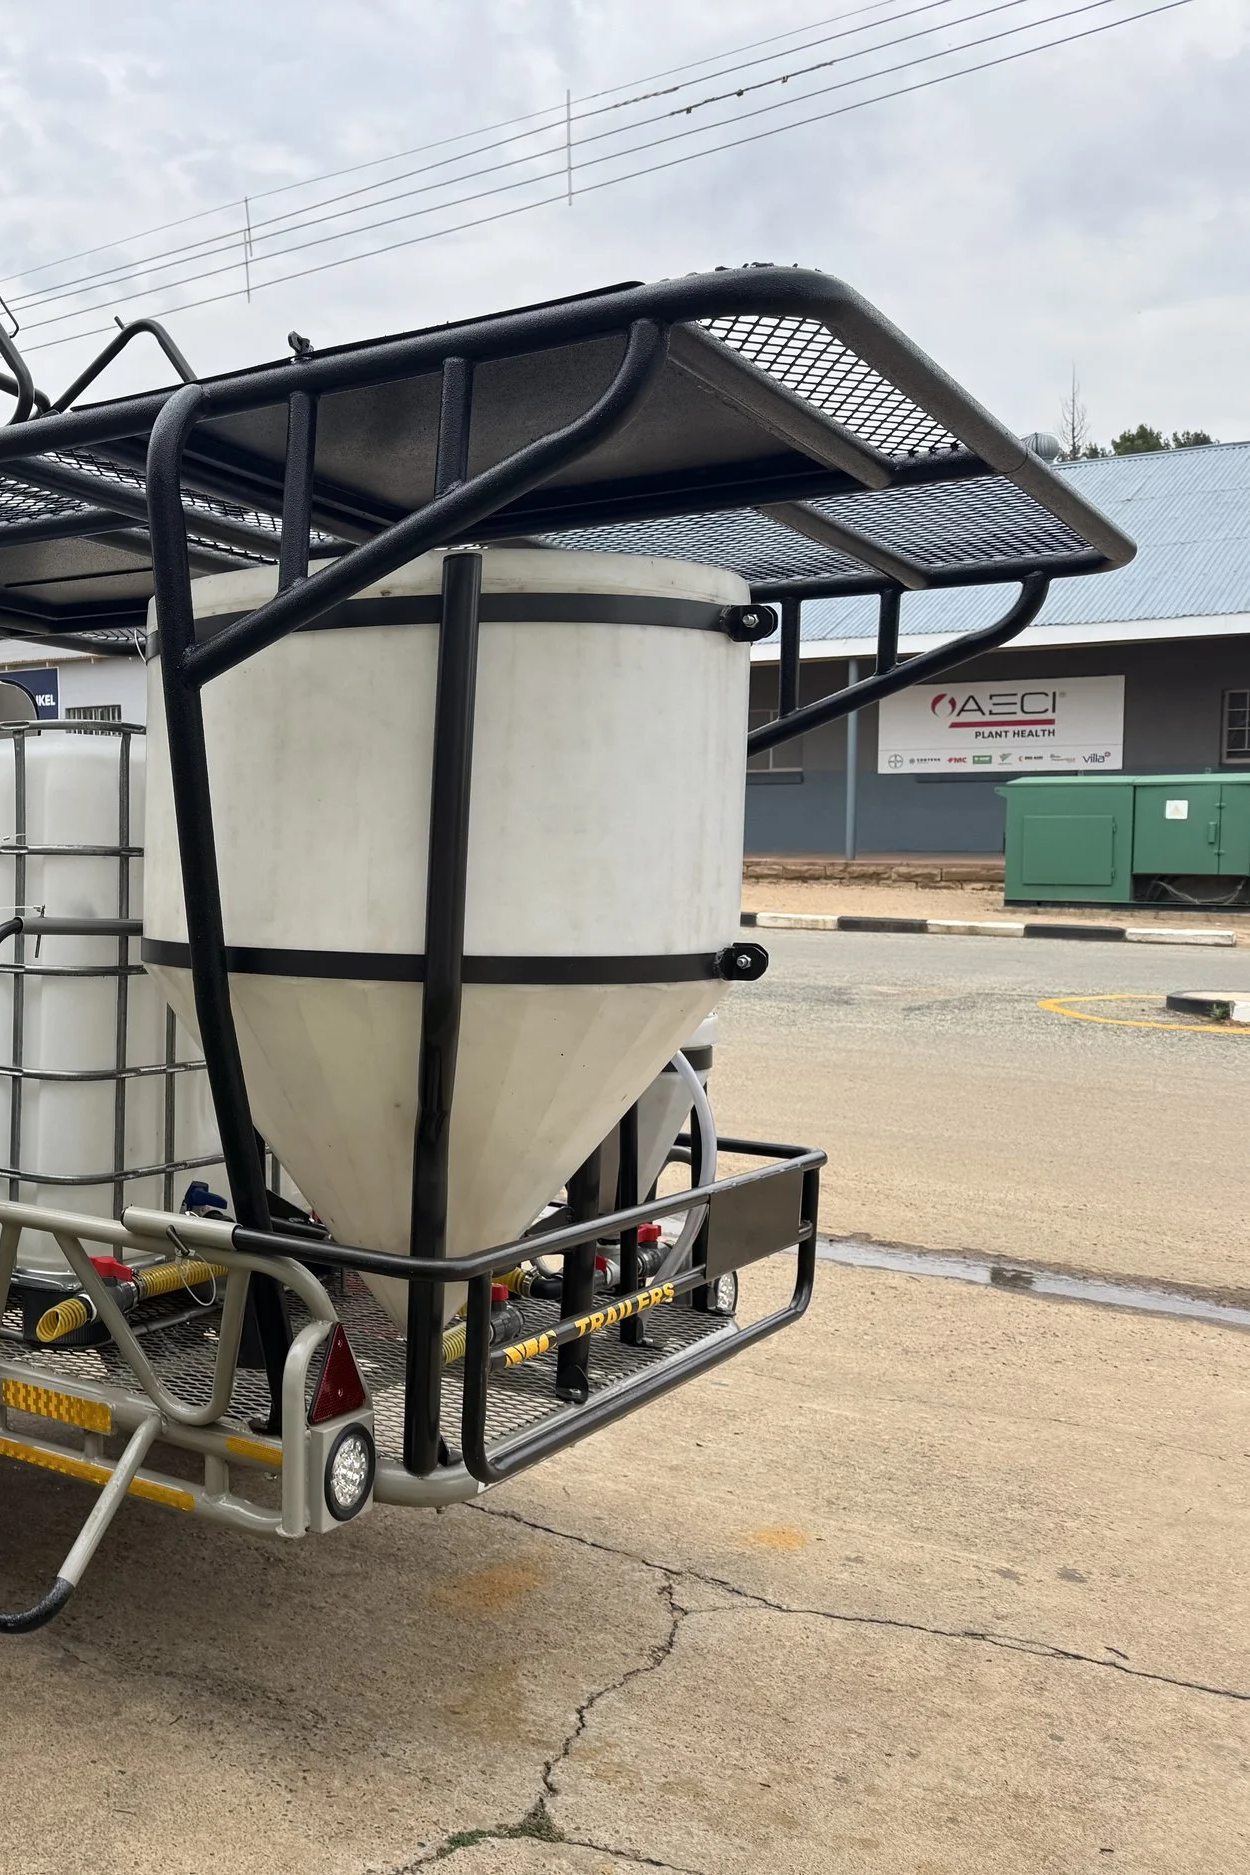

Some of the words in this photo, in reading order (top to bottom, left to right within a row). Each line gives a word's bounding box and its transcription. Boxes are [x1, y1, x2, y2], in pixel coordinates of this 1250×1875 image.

[956, 691, 1057, 717] AECI
[974, 730, 1010, 740] PLANT
[1012, 728, 1056, 738] HEALTH
[1082, 753, 1106, 764] villa
[574, 1282, 675, 1337] TRAILERS
